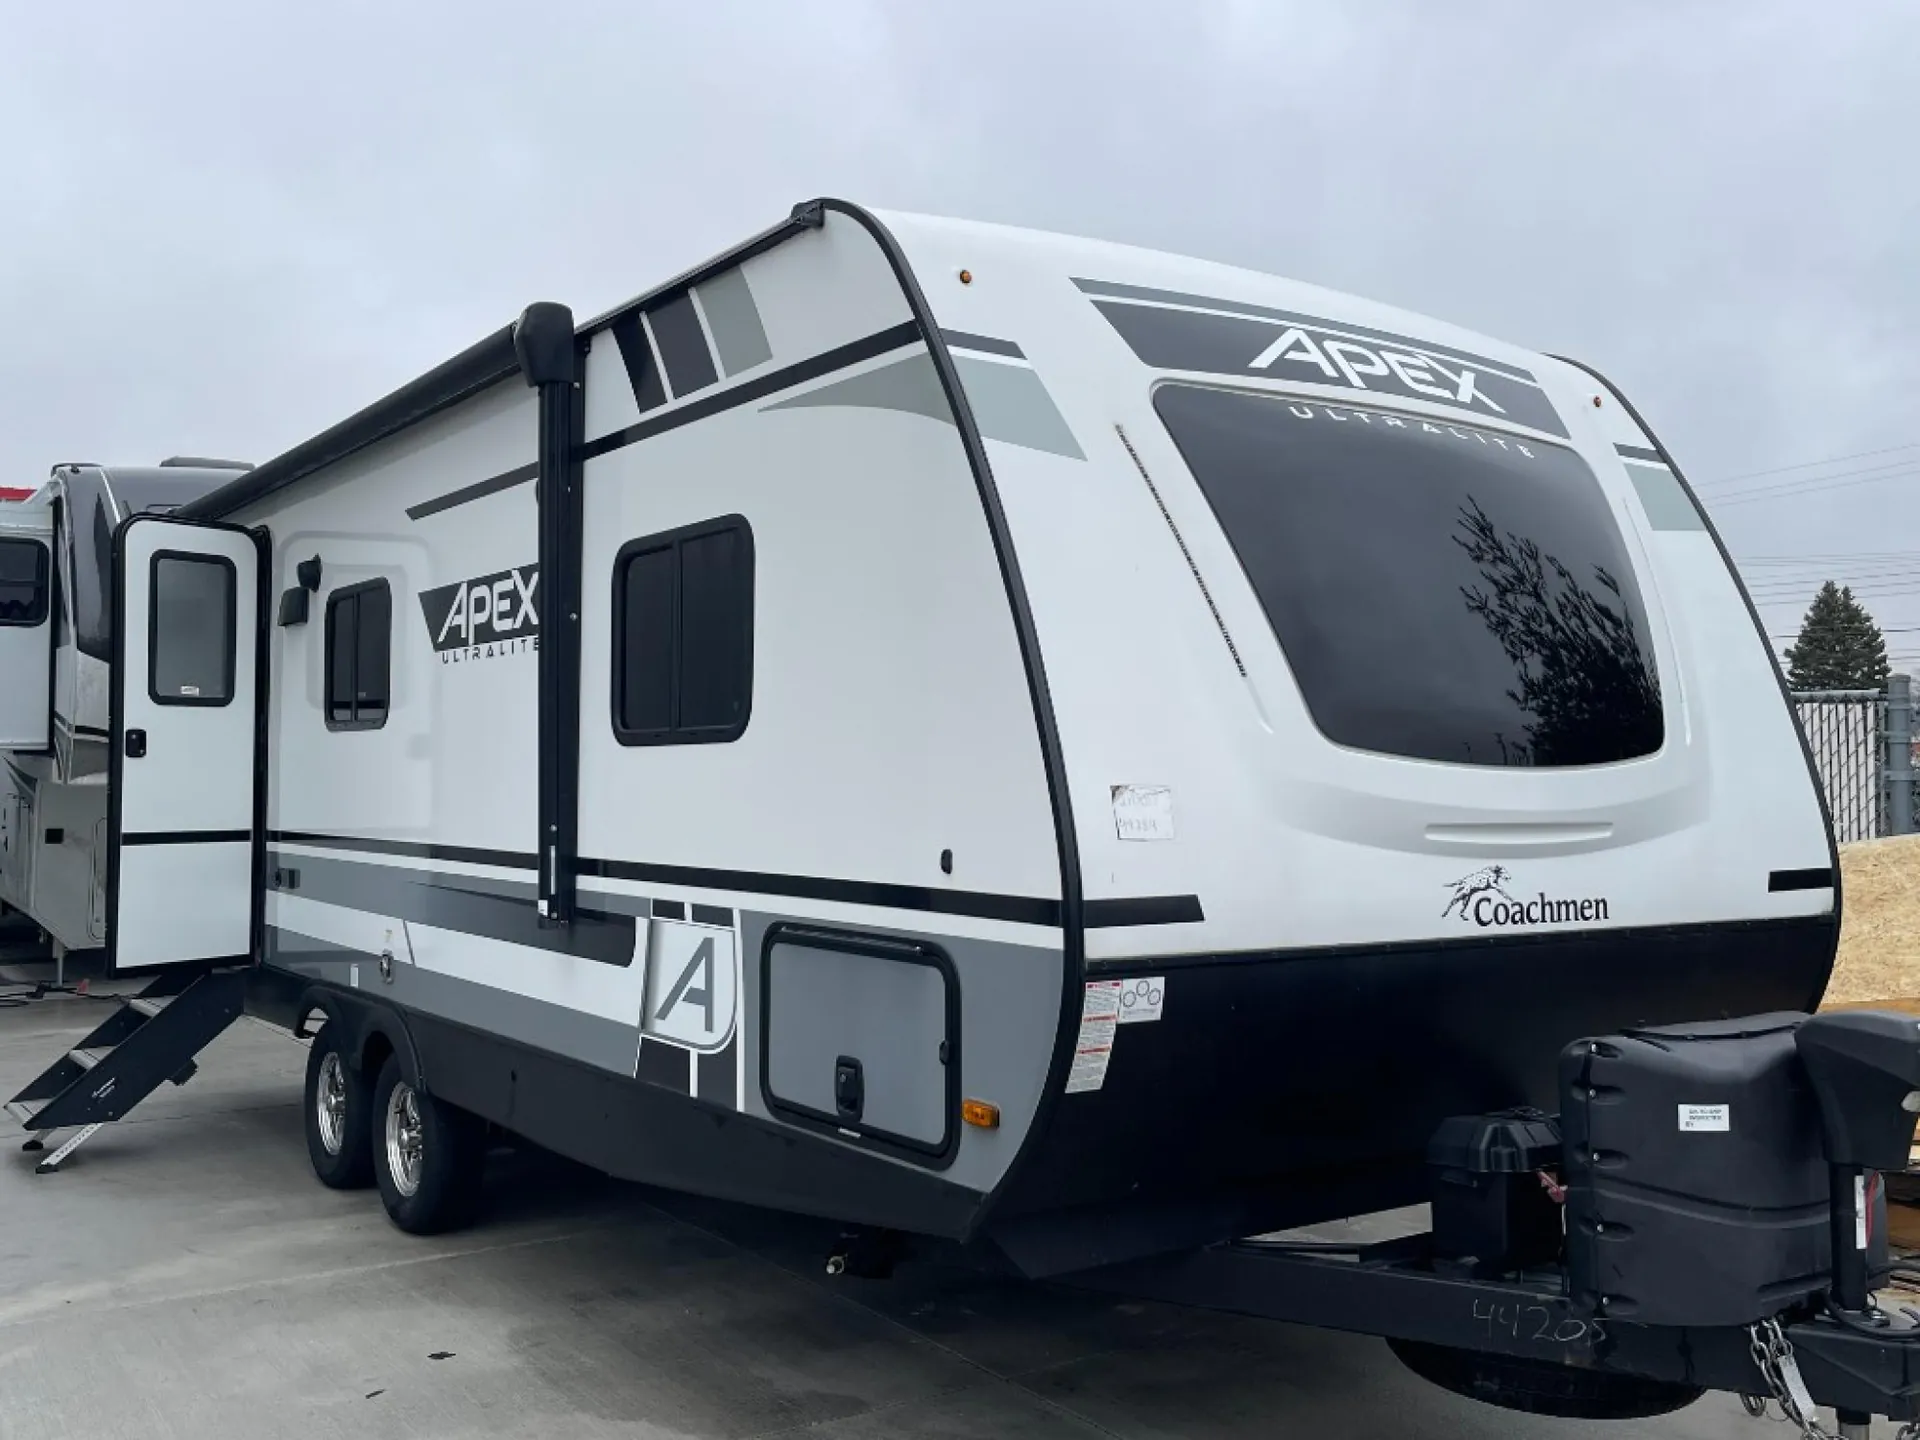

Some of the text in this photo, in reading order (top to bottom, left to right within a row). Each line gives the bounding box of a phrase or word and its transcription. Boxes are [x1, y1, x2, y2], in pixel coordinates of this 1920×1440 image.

[1248, 328, 1507, 413] APEX
[1288, 405, 1536, 459] ULTRALITE
[437, 569, 539, 645] APEX
[1474, 892, 1610, 927] Coachmen
